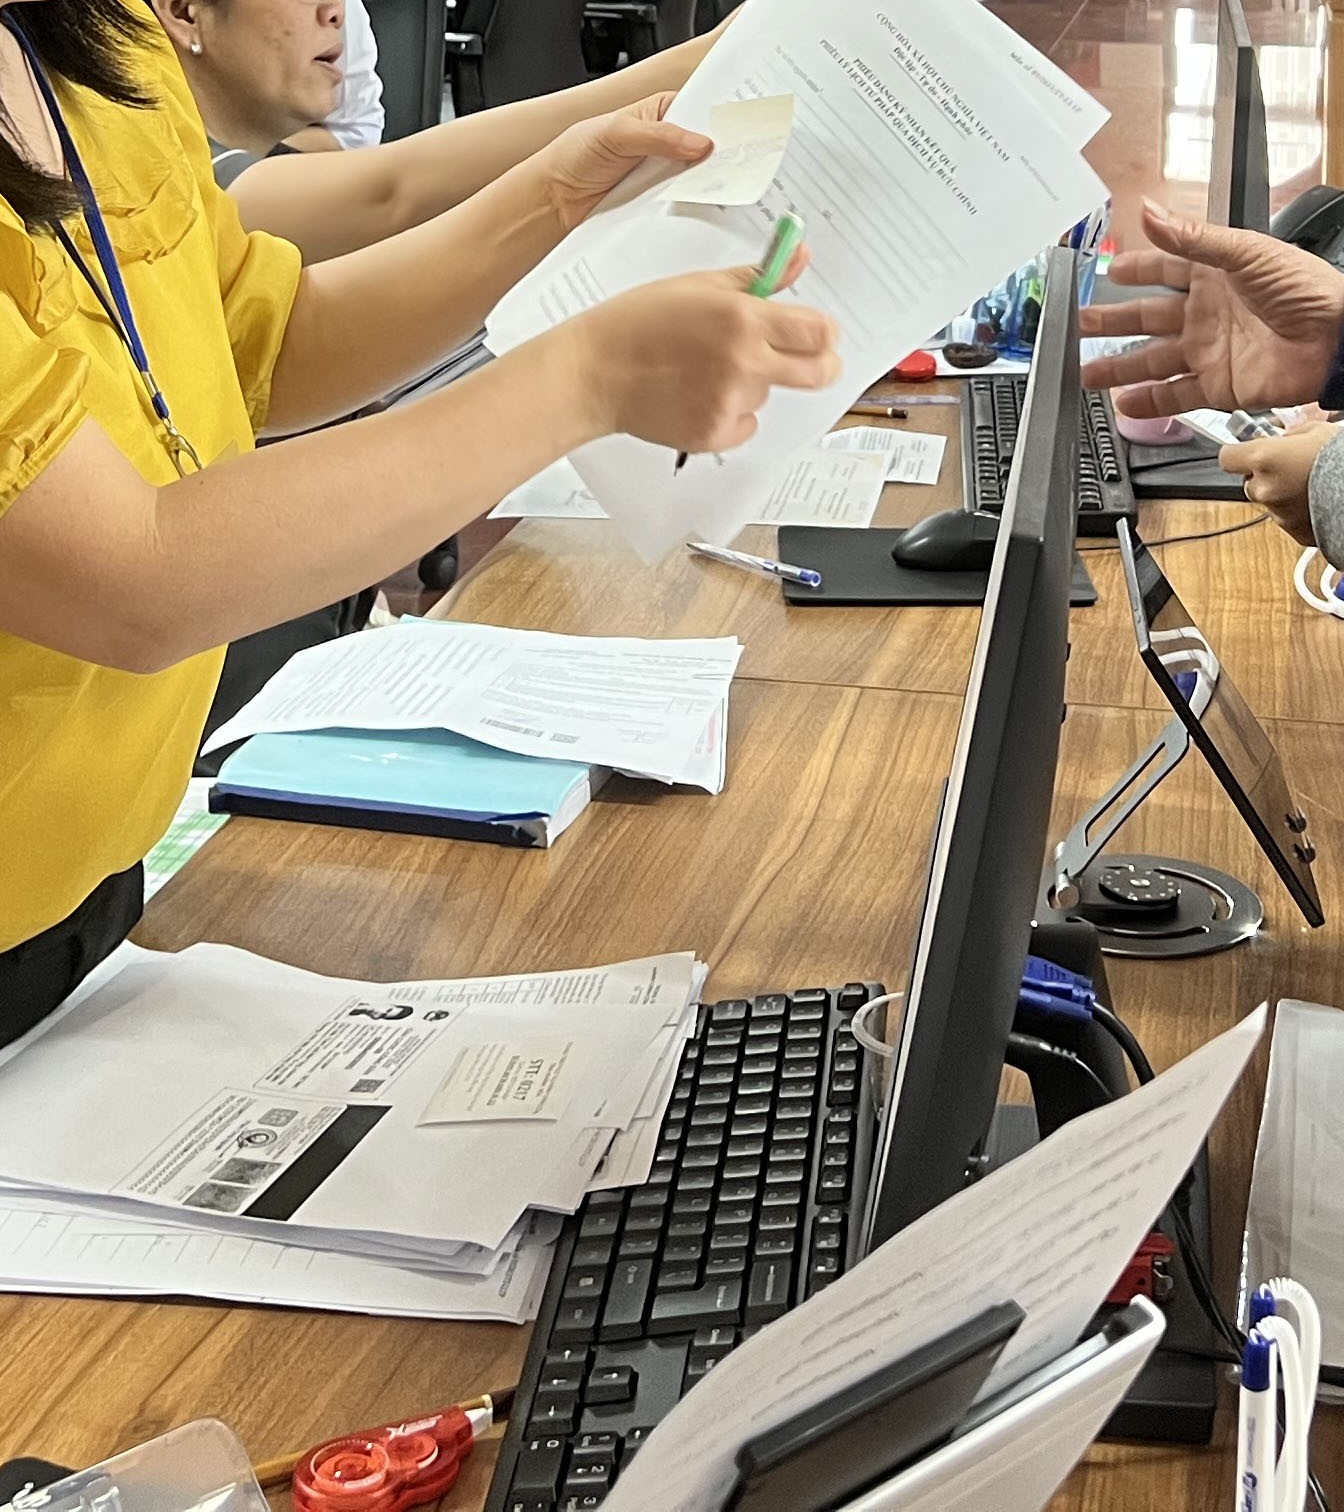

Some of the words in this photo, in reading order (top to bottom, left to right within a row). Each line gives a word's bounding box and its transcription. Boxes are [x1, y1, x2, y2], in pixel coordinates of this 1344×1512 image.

[874, 97, 894, 118] PHÁP
[546, 1439, 560, 1448] 0
[591, 1465, 604, 1473] 2
[583, 1496, 597, 1505] 3
